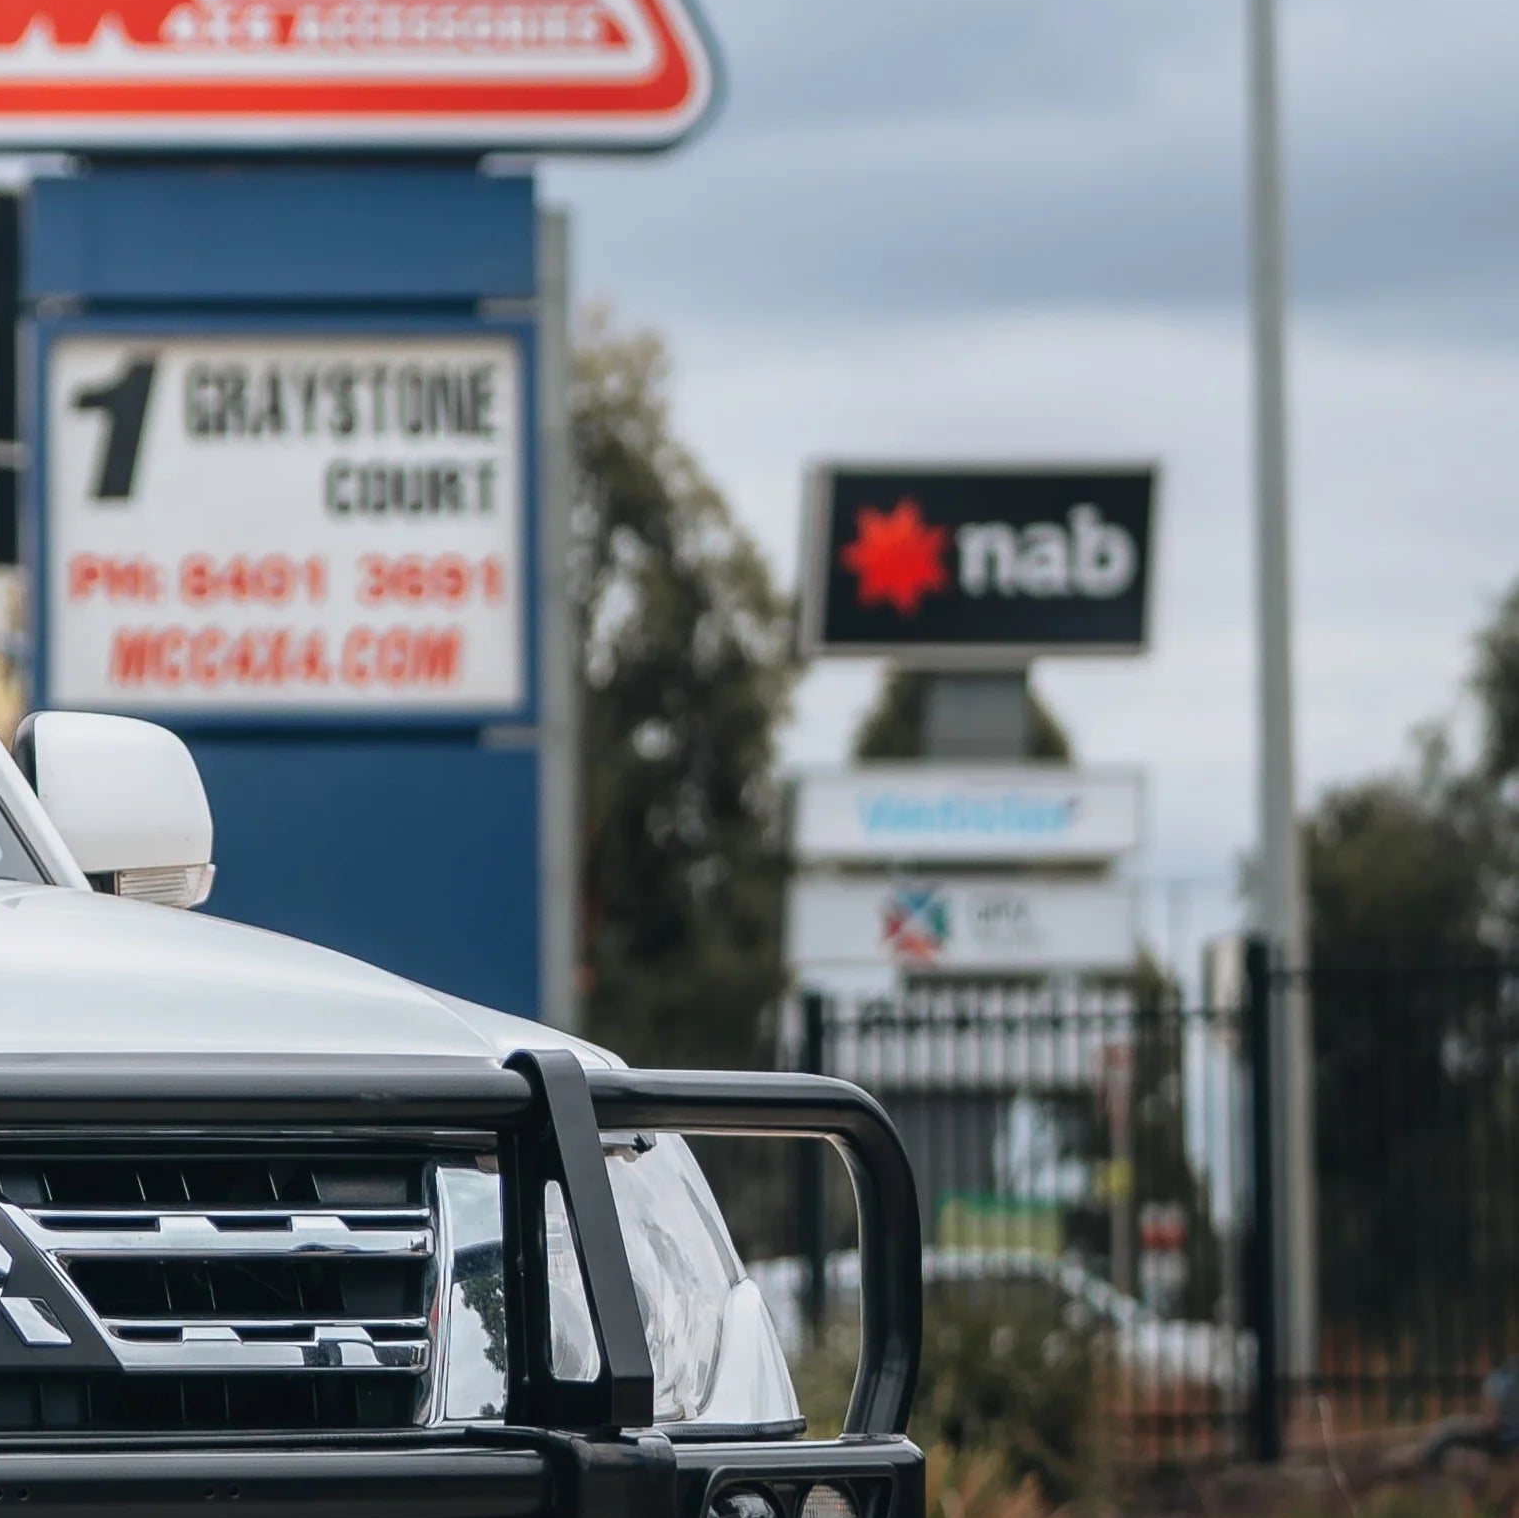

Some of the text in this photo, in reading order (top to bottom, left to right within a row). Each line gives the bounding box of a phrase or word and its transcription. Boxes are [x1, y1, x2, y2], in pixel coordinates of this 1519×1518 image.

[73, 353, 498, 499] 1 GRAYSTONE
[323, 457, 497, 516] COURT
[955, 503, 1137, 598] nab
